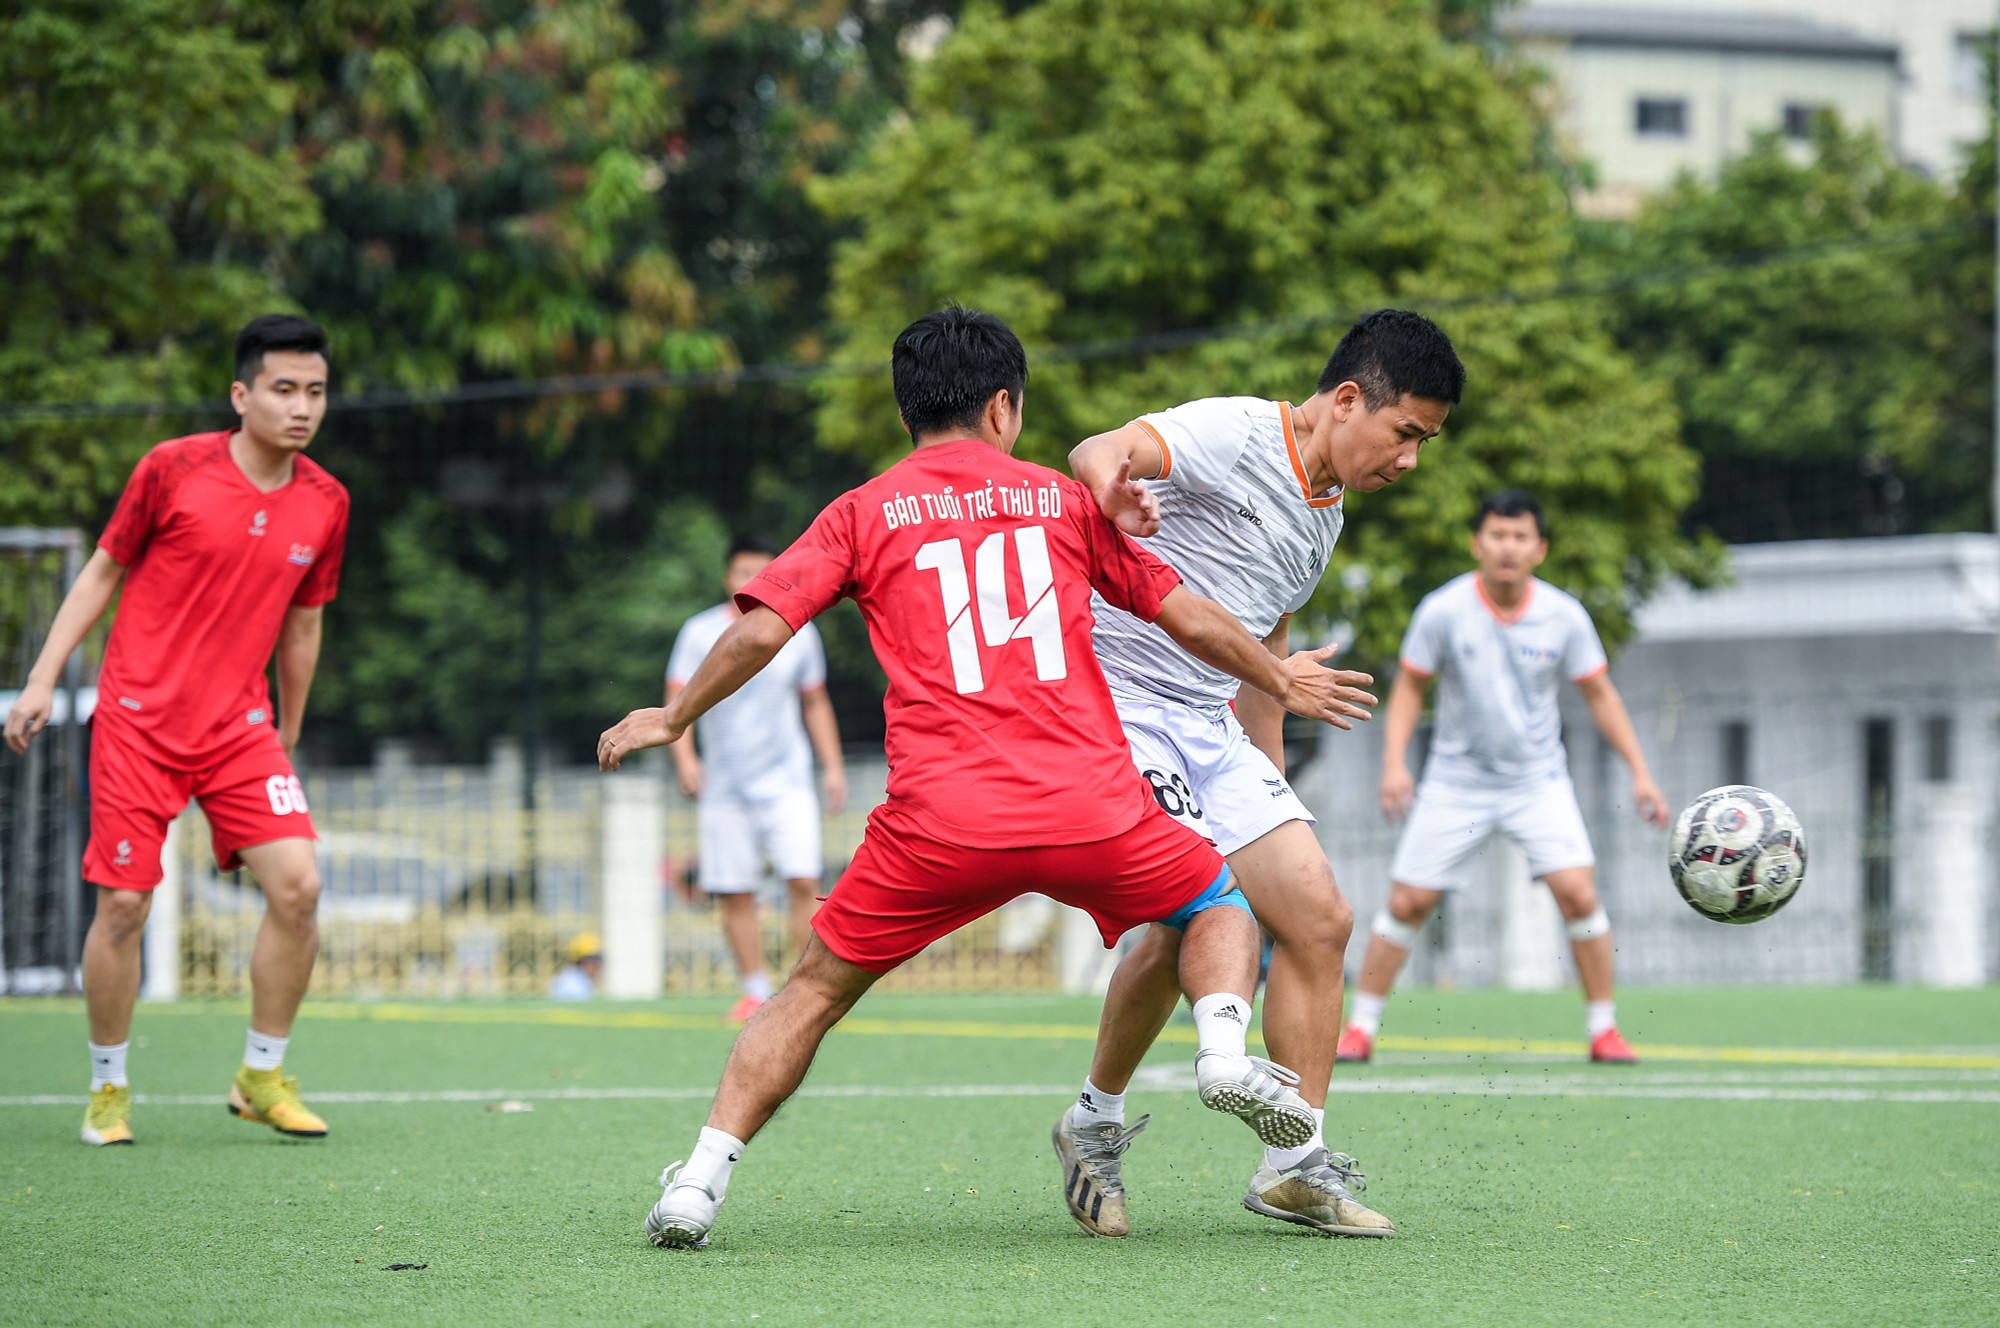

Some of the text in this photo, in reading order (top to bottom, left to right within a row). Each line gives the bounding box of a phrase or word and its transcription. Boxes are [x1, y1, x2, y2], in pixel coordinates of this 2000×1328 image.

[881, 479, 1062, 531] BÁO TUỔI TRẺ THỦ ĐÔ
[914, 525, 1068, 695] 14
